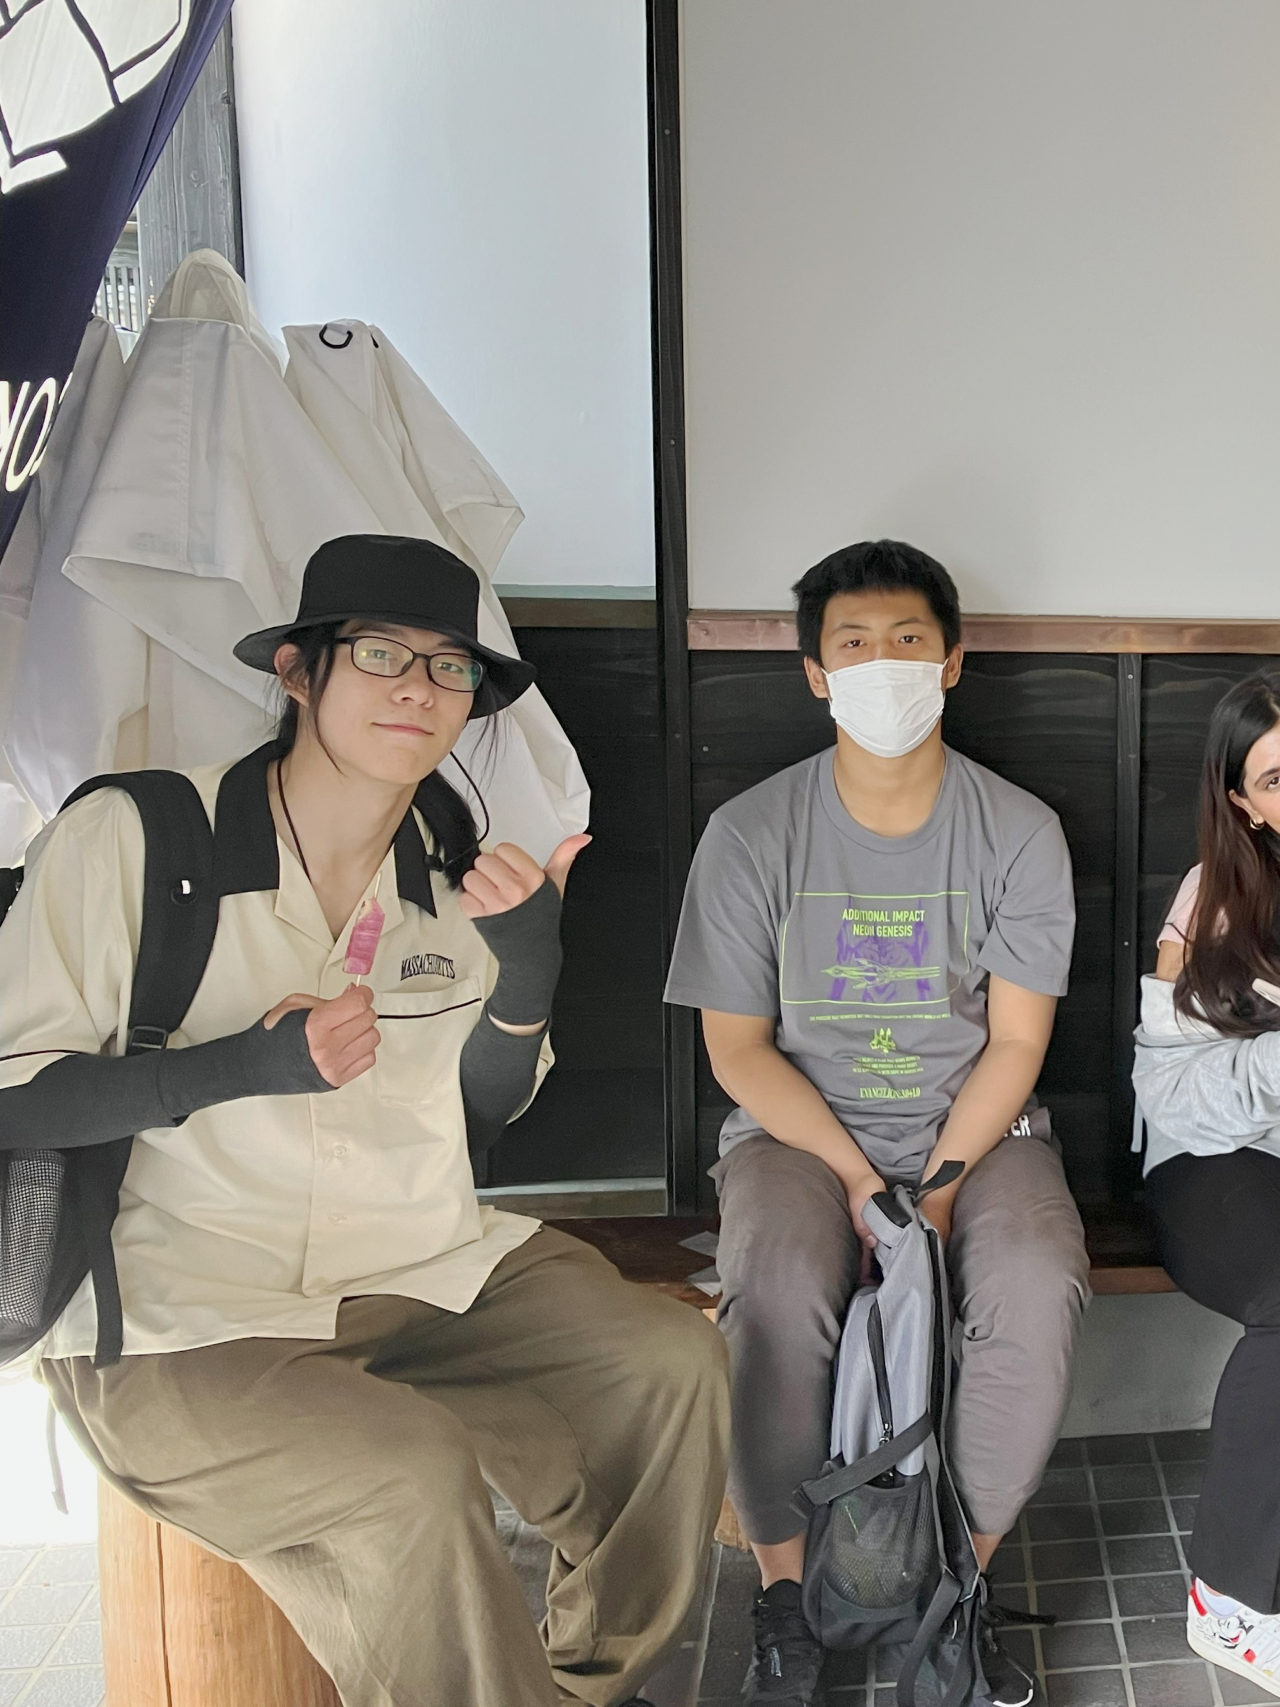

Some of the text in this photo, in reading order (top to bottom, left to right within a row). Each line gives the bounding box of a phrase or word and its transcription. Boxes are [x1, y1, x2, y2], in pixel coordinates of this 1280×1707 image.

[842, 908, 925, 922] ADDITIONAL IMPACT
[853, 924, 913, 937] NEON GENESIS
